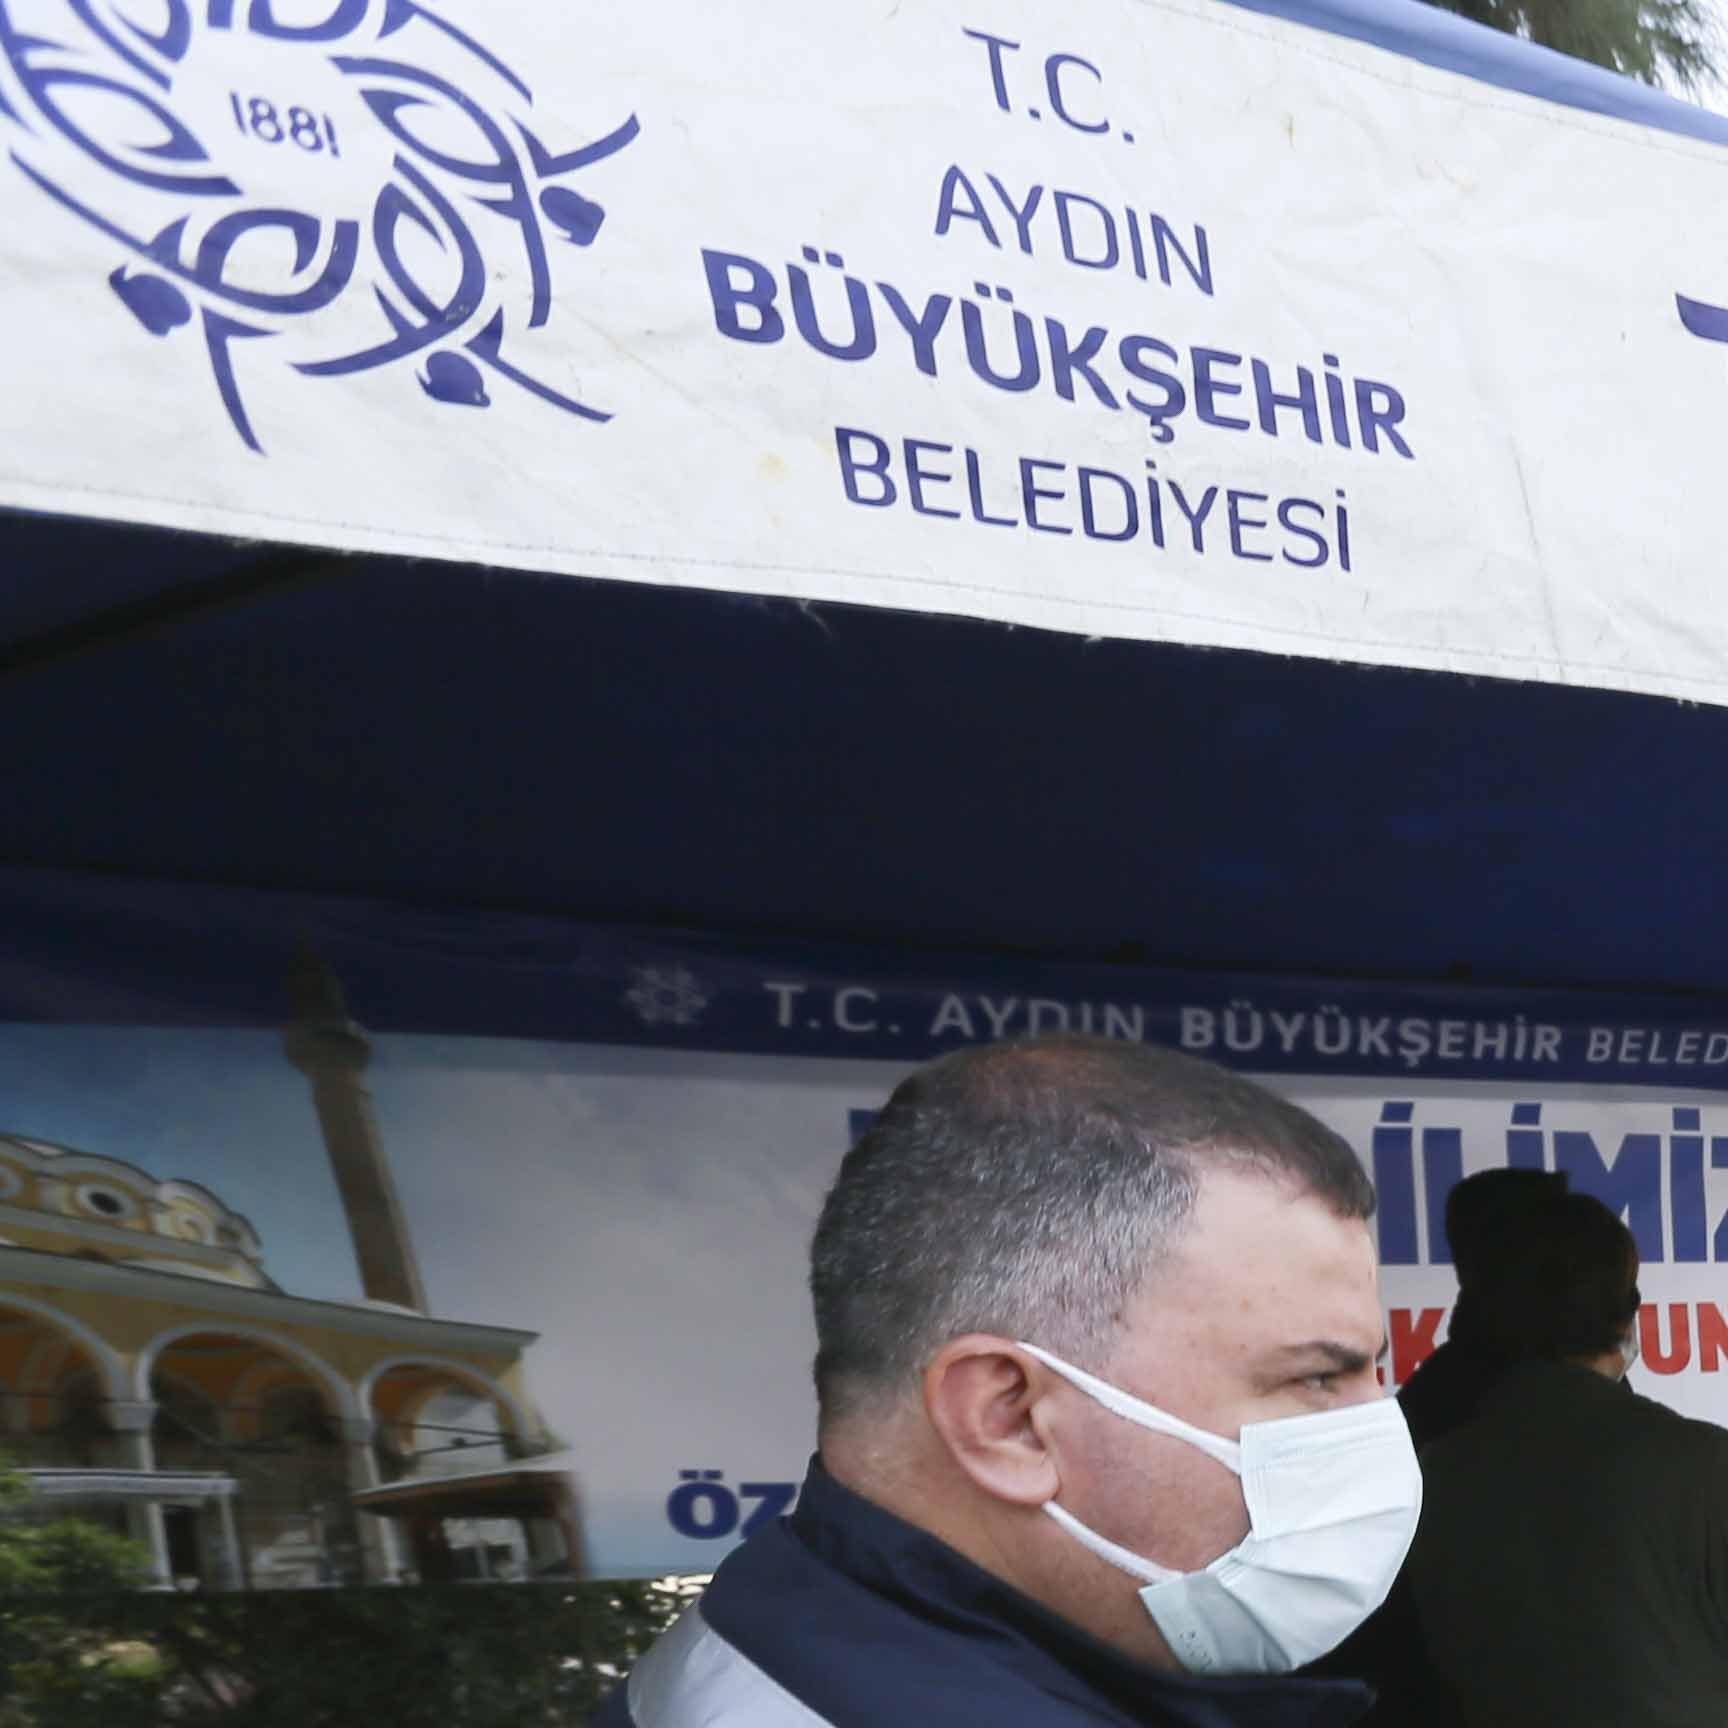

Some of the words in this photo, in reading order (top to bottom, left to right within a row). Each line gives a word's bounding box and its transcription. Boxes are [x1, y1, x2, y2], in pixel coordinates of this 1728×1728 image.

[964, 29, 1134, 143] T.C.
[934, 165, 1214, 294] AYDIN
[700, 247, 1415, 458] BÜYÜKŞEHİR
[834, 425, 1353, 571] BELEDİYESİ
[763, 981, 901, 1034] T.C.
[930, 993, 1146, 1042] AYDIN
[1180, 1000, 1563, 1068] BÜYÜKŞEHİR
[666, 1470, 797, 1540] ÖZ
